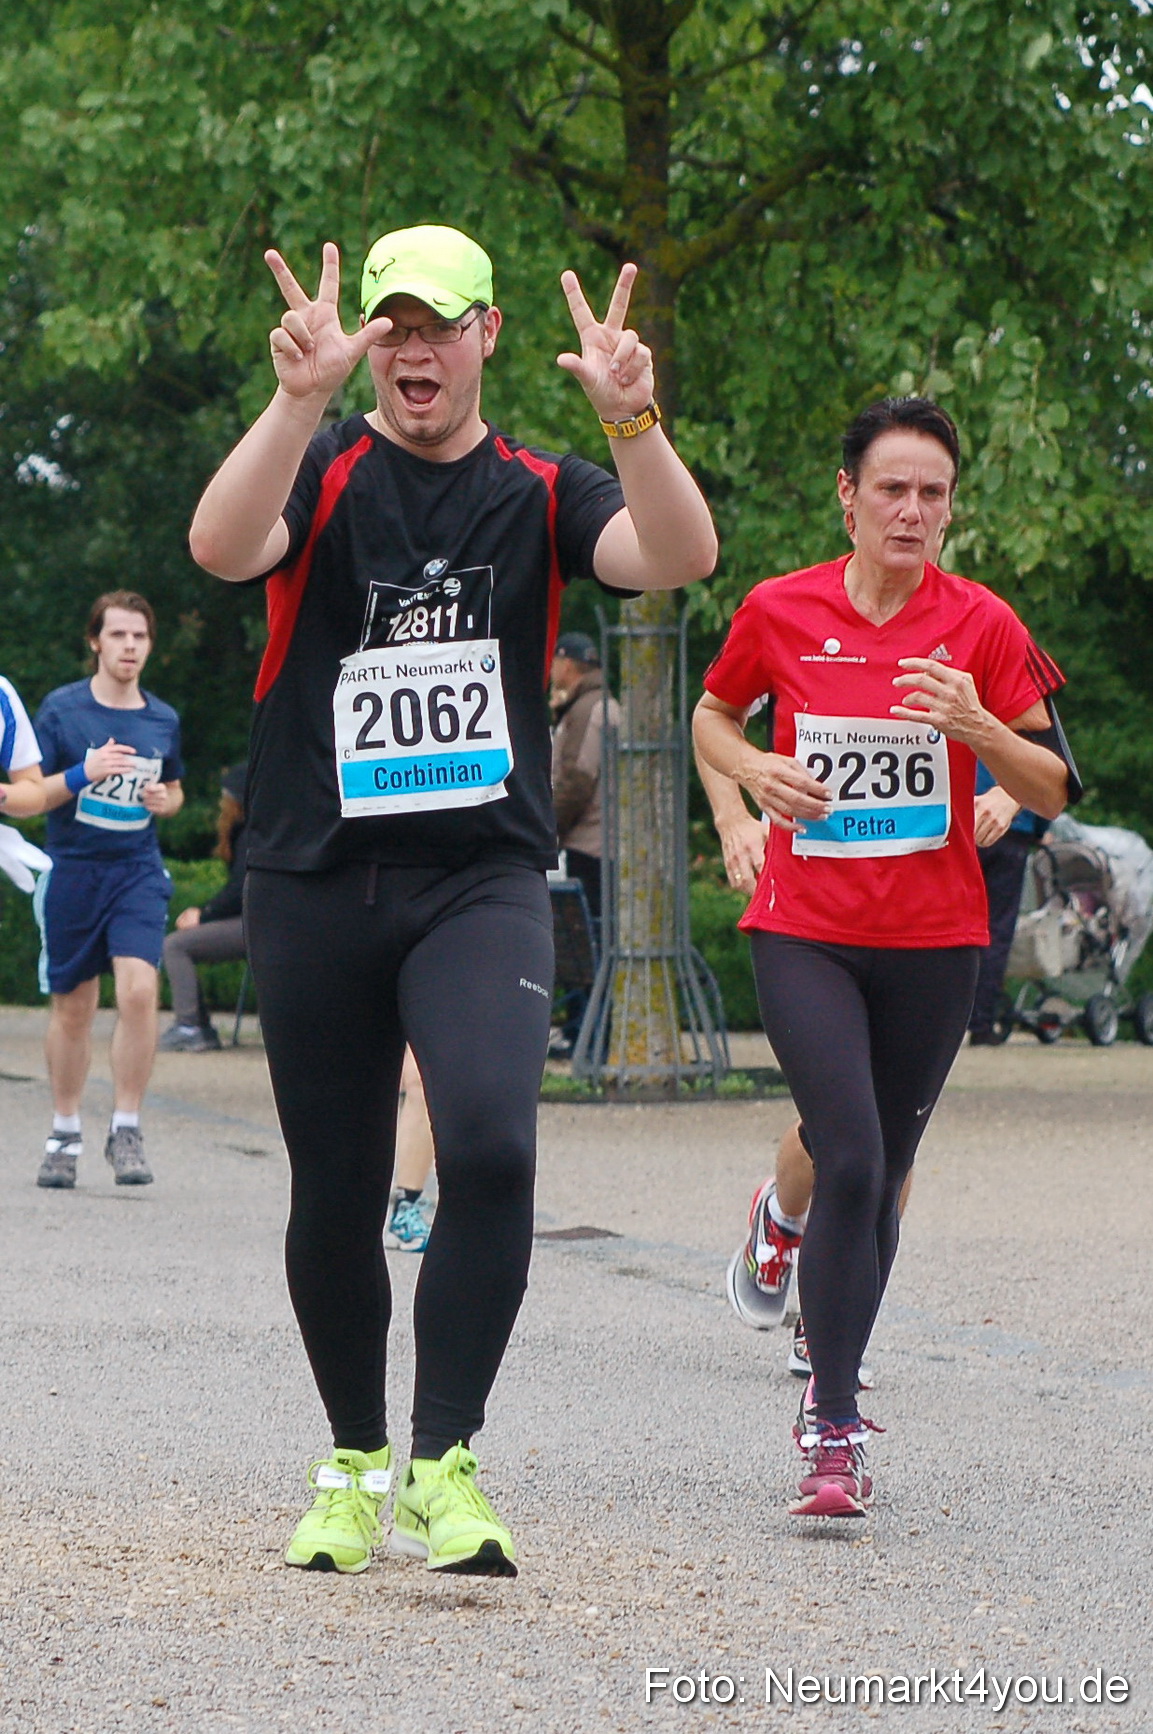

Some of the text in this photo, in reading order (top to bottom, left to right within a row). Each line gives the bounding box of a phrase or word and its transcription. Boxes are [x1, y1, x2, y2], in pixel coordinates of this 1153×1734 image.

[386, 602, 459, 642] 12811
[340, 665, 391, 685] PARTL
[396, 659, 474, 679] Neumarkt
[352, 682, 492, 750] 2062
[799, 728, 843, 745] PARTL
[847, 732, 921, 746] Neumarkt
[344, 750, 351, 760] C
[374, 761, 483, 790] Corbinian
[806, 751, 935, 801] 2236
[843, 816, 896, 837] Petra
